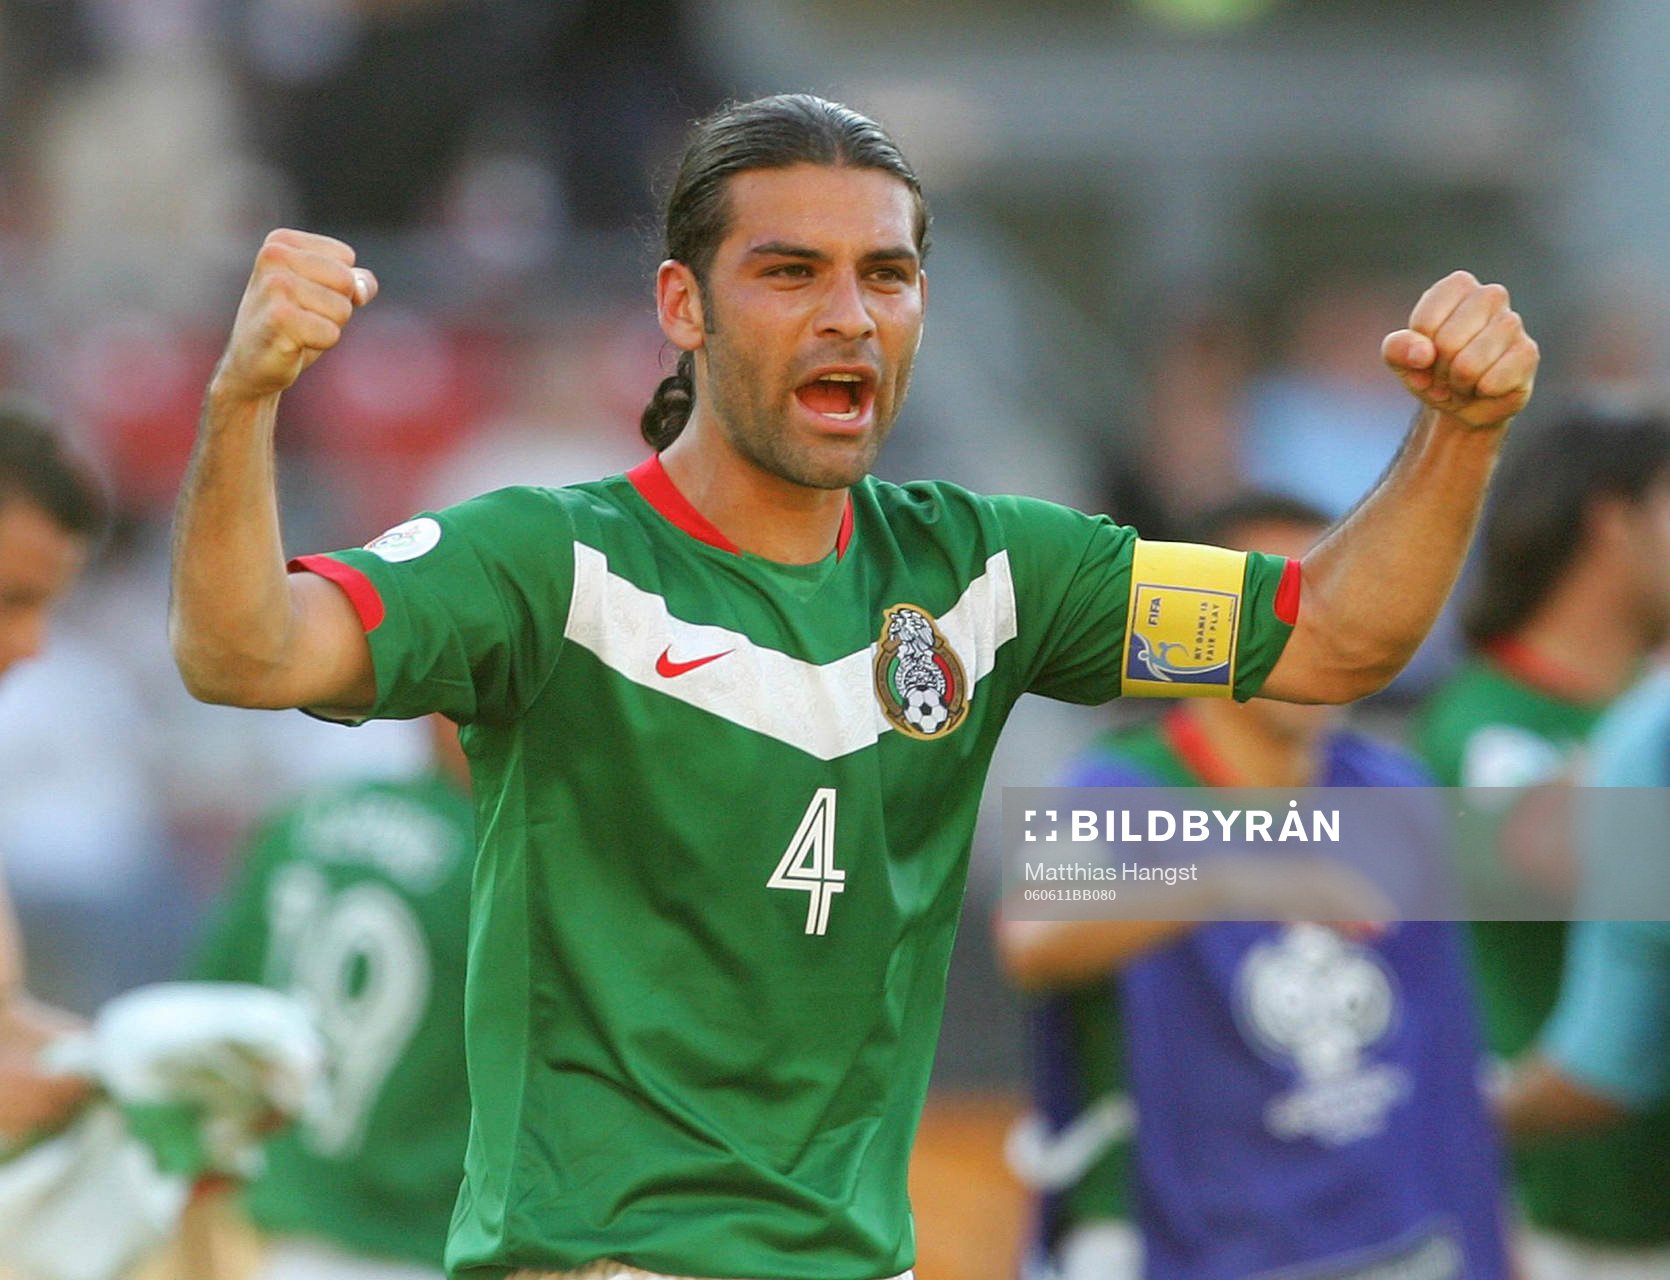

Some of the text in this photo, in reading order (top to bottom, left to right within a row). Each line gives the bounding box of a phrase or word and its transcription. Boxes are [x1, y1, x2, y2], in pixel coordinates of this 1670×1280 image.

[1148, 597, 1161, 625] FIFA
[1206, 604, 1219, 661] FAIR PLAY
[766, 788, 845, 935] 4
